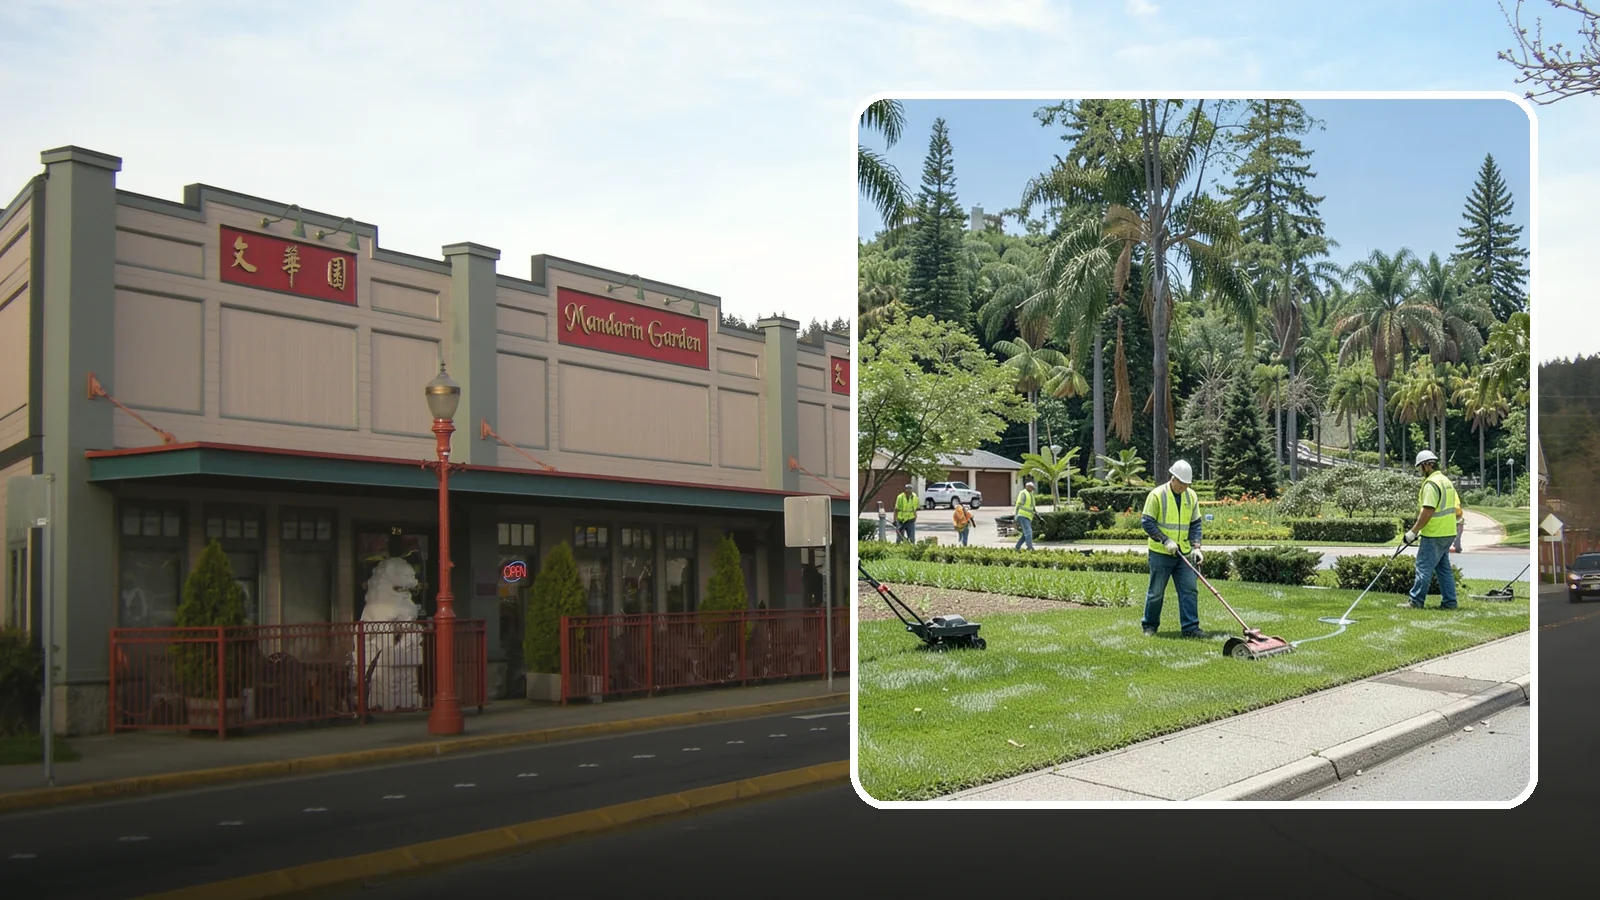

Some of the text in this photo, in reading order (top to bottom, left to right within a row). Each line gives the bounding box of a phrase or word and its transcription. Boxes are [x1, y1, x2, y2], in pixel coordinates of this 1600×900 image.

[230, 235, 346, 291] 文華園
[564, 302, 702, 352] Mandarin Garden
[503, 565, 527, 578] OPEN
